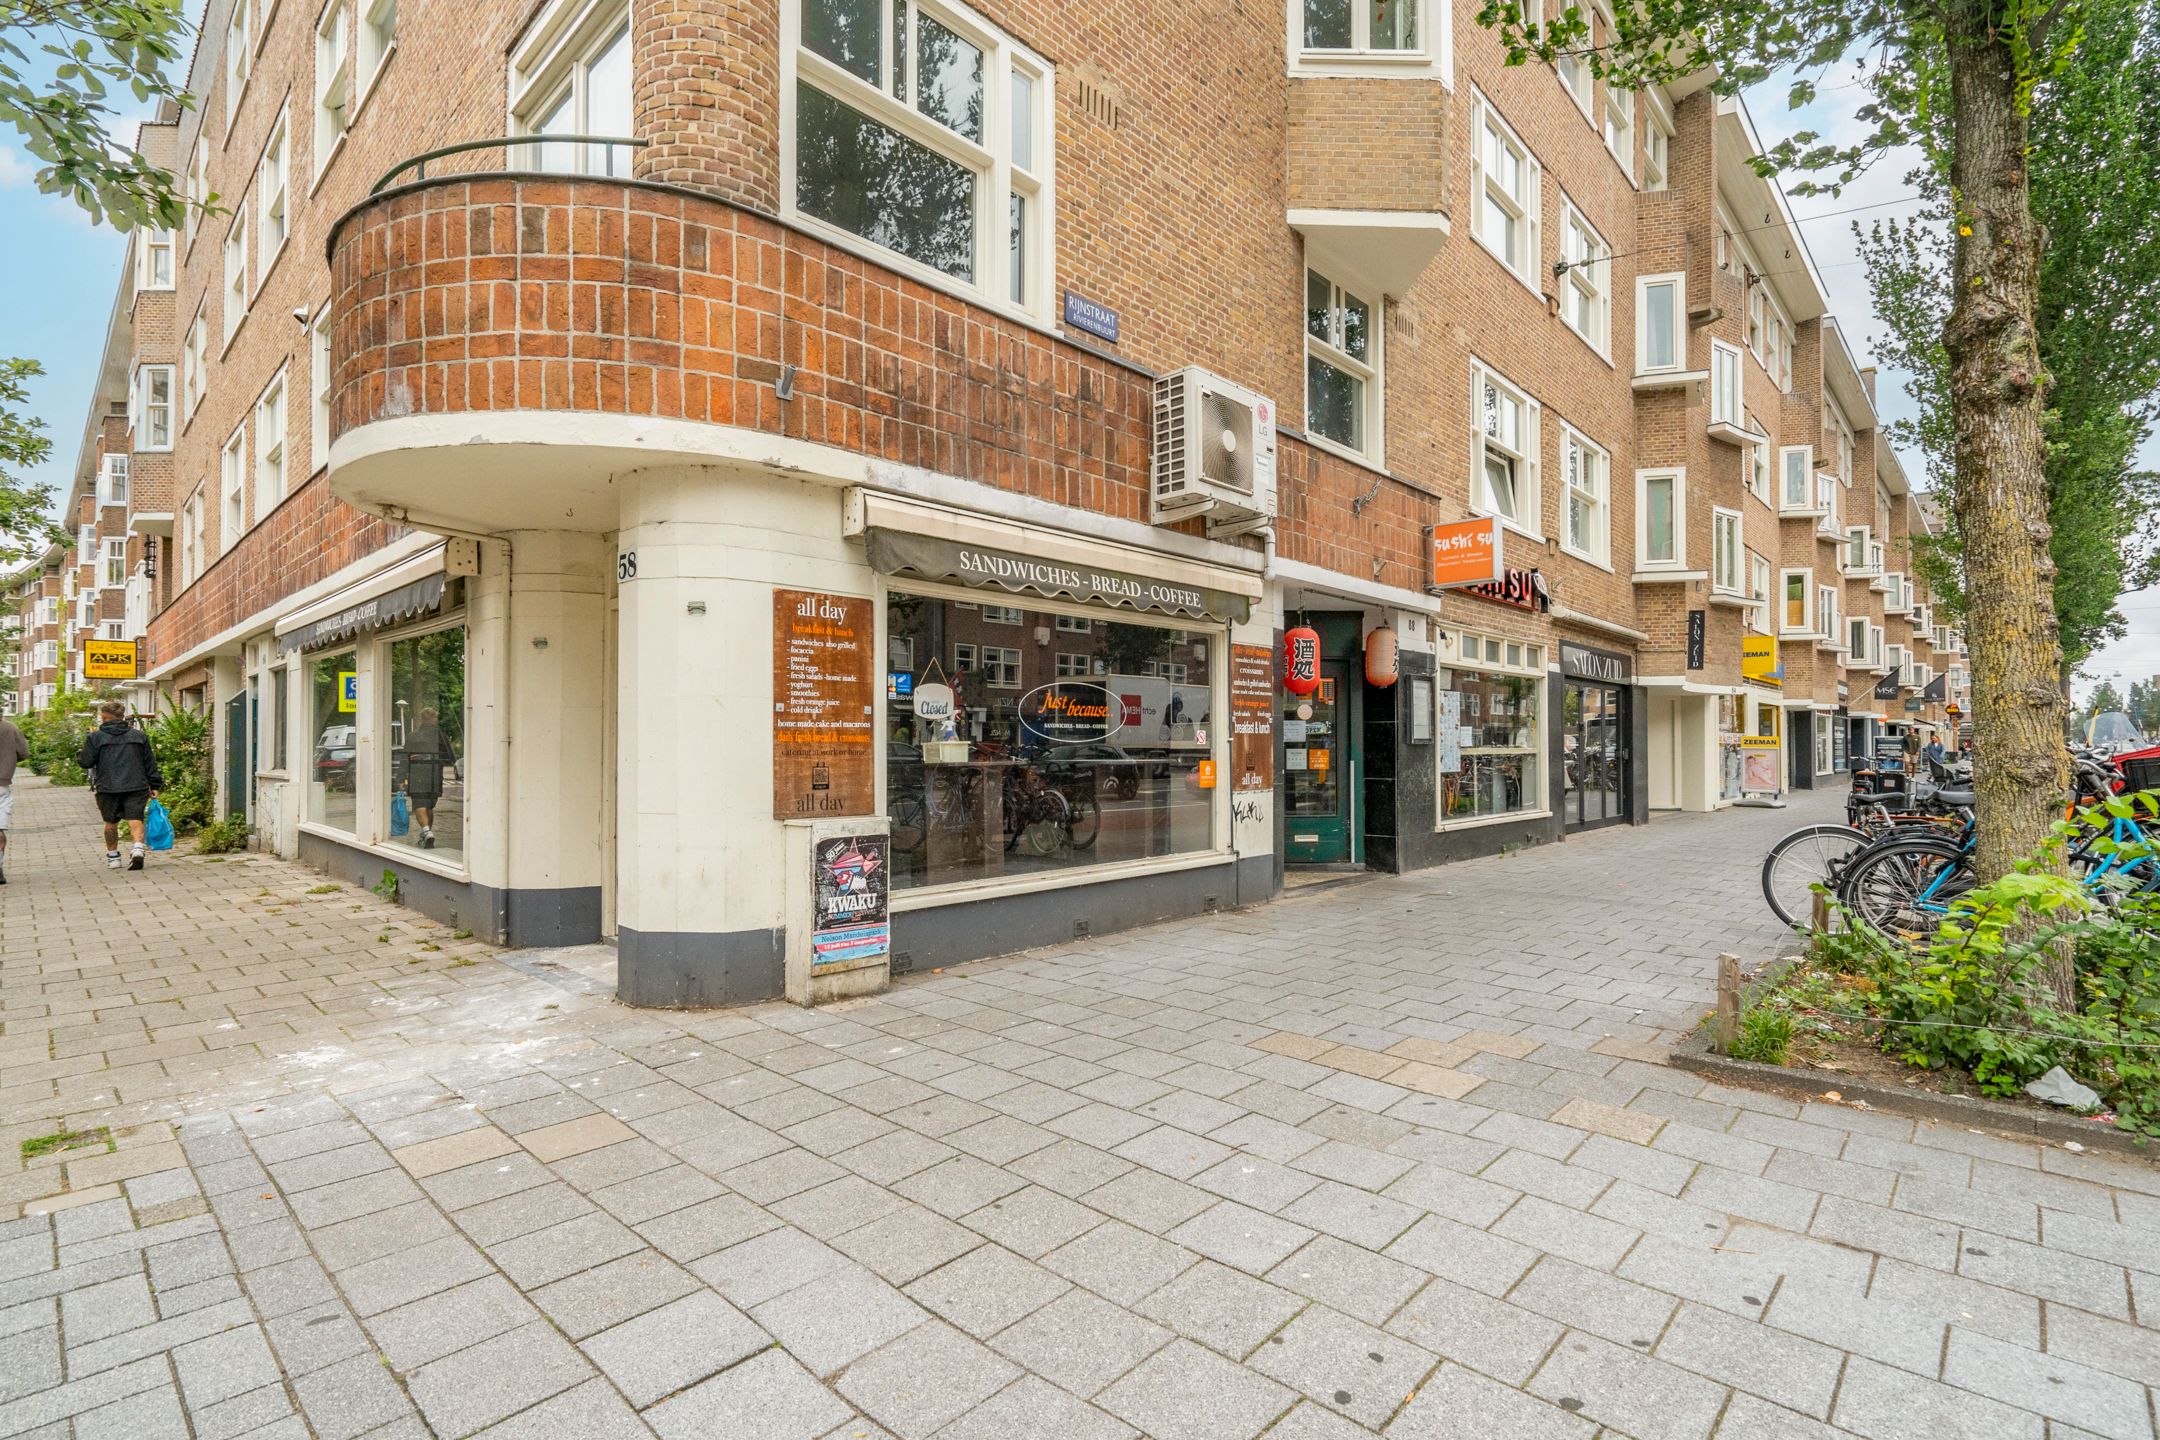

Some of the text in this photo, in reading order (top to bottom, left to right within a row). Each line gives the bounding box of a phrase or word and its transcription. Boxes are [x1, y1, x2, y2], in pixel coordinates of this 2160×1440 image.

[1069, 295, 1115, 327] RIJNSTRAAT
[1258, 424, 1268, 437] LG
[1434, 532, 1493, 552] sushi su
[619, 551, 637, 580] 58
[960, 551, 1080, 588] SANDWICHES
[1091, 574, 1141, 598] BREAD
[1150, 585, 1201, 608] COFFEE
[797, 598, 847, 625] all day
[792, 623, 854, 637] breakfast & lunch
[790, 646, 814, 654] focaccia
[791, 638, 824, 647] sandwiches
[837, 642, 856, 650] grilled
[91, 653, 129, 662] APK
[790, 681, 813, 689] yoghurt
[921, 700, 948, 715] Closed
[1038, 689, 1068, 714] Just
[790, 706, 822, 714] cold drinks
[1234, 720, 1254, 734] breakfast
[1259, 721, 1271, 734] lunch
[795, 731, 812, 743] fresh
[839, 733, 870, 743] croissants
[1241, 772, 1263, 788] all day
[797, 792, 846, 815] all day
[825, 850, 835, 861] 50
[828, 893, 877, 914] KWAKU
[821, 935, 843, 943] Nelson
